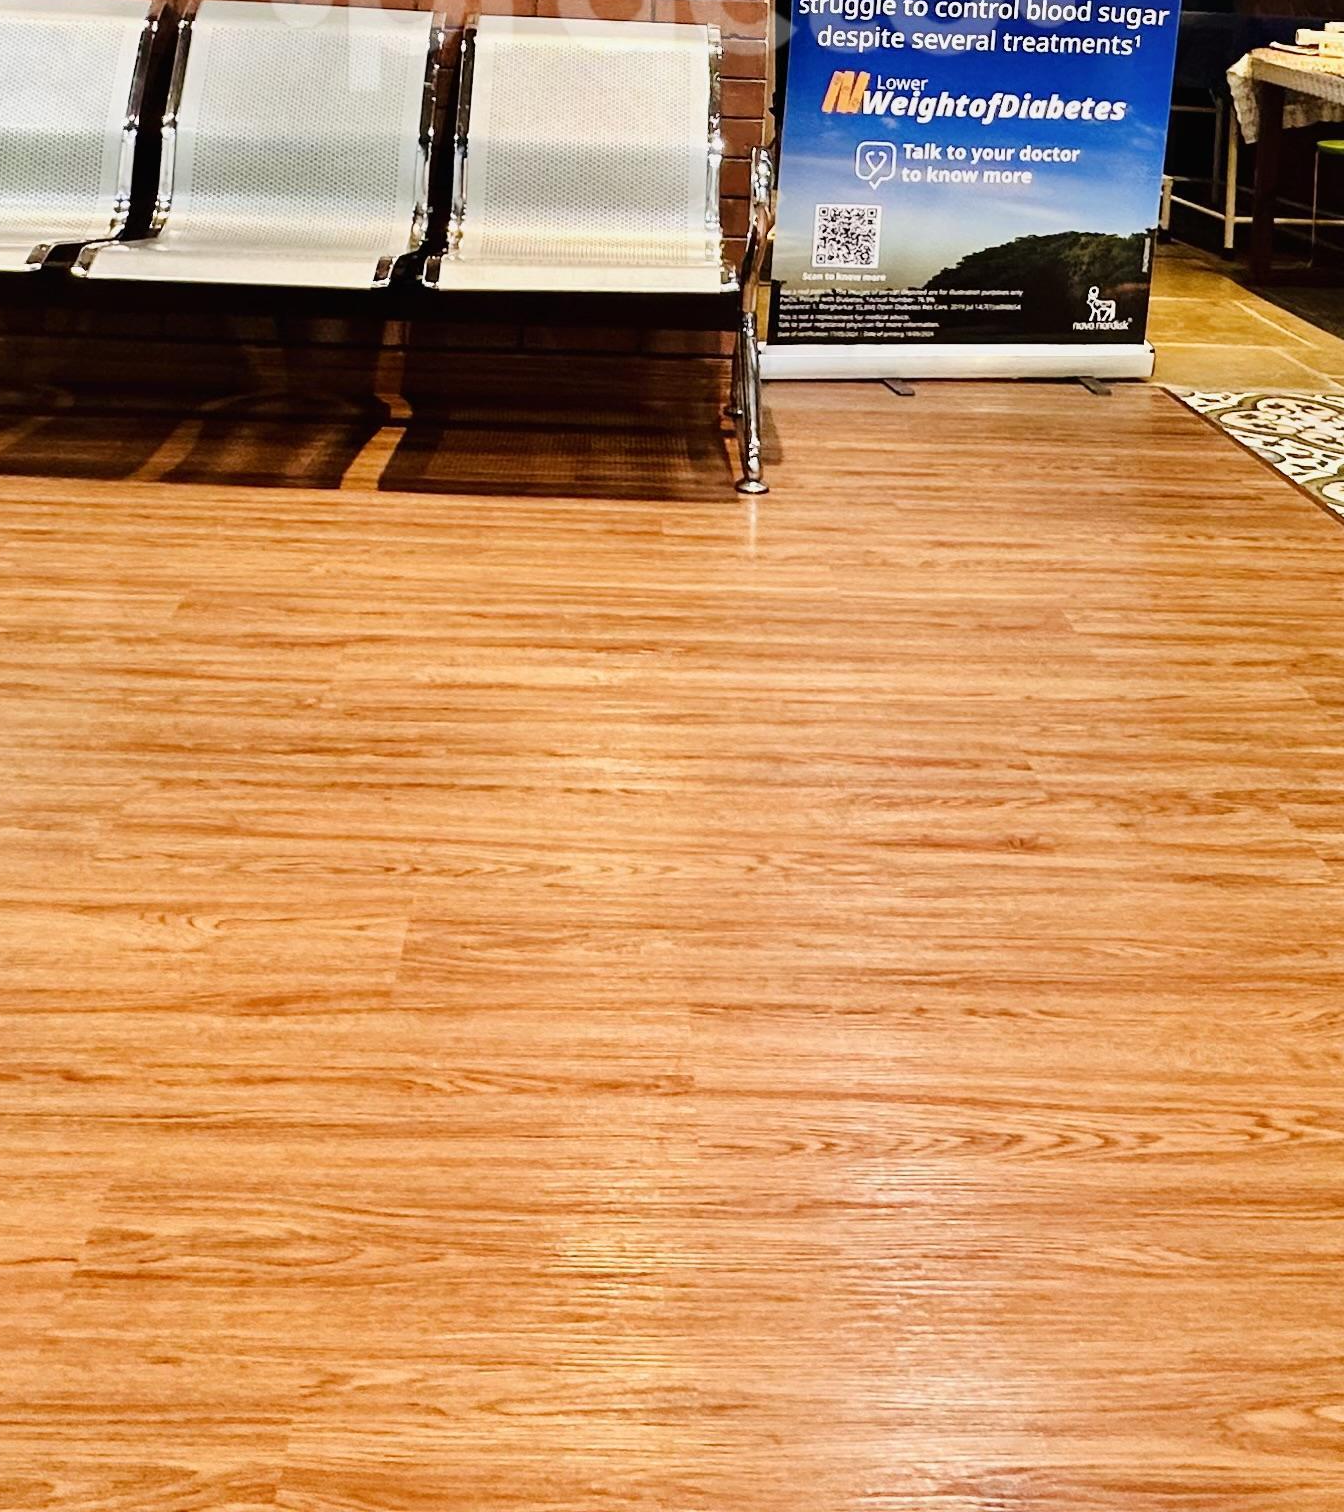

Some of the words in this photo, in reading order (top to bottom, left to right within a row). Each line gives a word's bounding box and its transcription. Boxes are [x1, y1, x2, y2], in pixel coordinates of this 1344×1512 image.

[1097, 6, 1170, 30] sugar
[817, 25, 906, 54] despite
[911, 29, 996, 52] several
[877, 75, 928, 91] Lower
[862, 90, 1127, 125] WeightofDiabetes
[902, 143, 941, 160] Talk
[947, 146, 967, 161] to
[971, 147, 1016, 165] your
[1019, 145, 1080, 162] doctor
[902, 167, 921, 182] to
[926, 167, 979, 183] know
[983, 169, 1033, 184] more
[1072, 321, 1096, 330] novo
